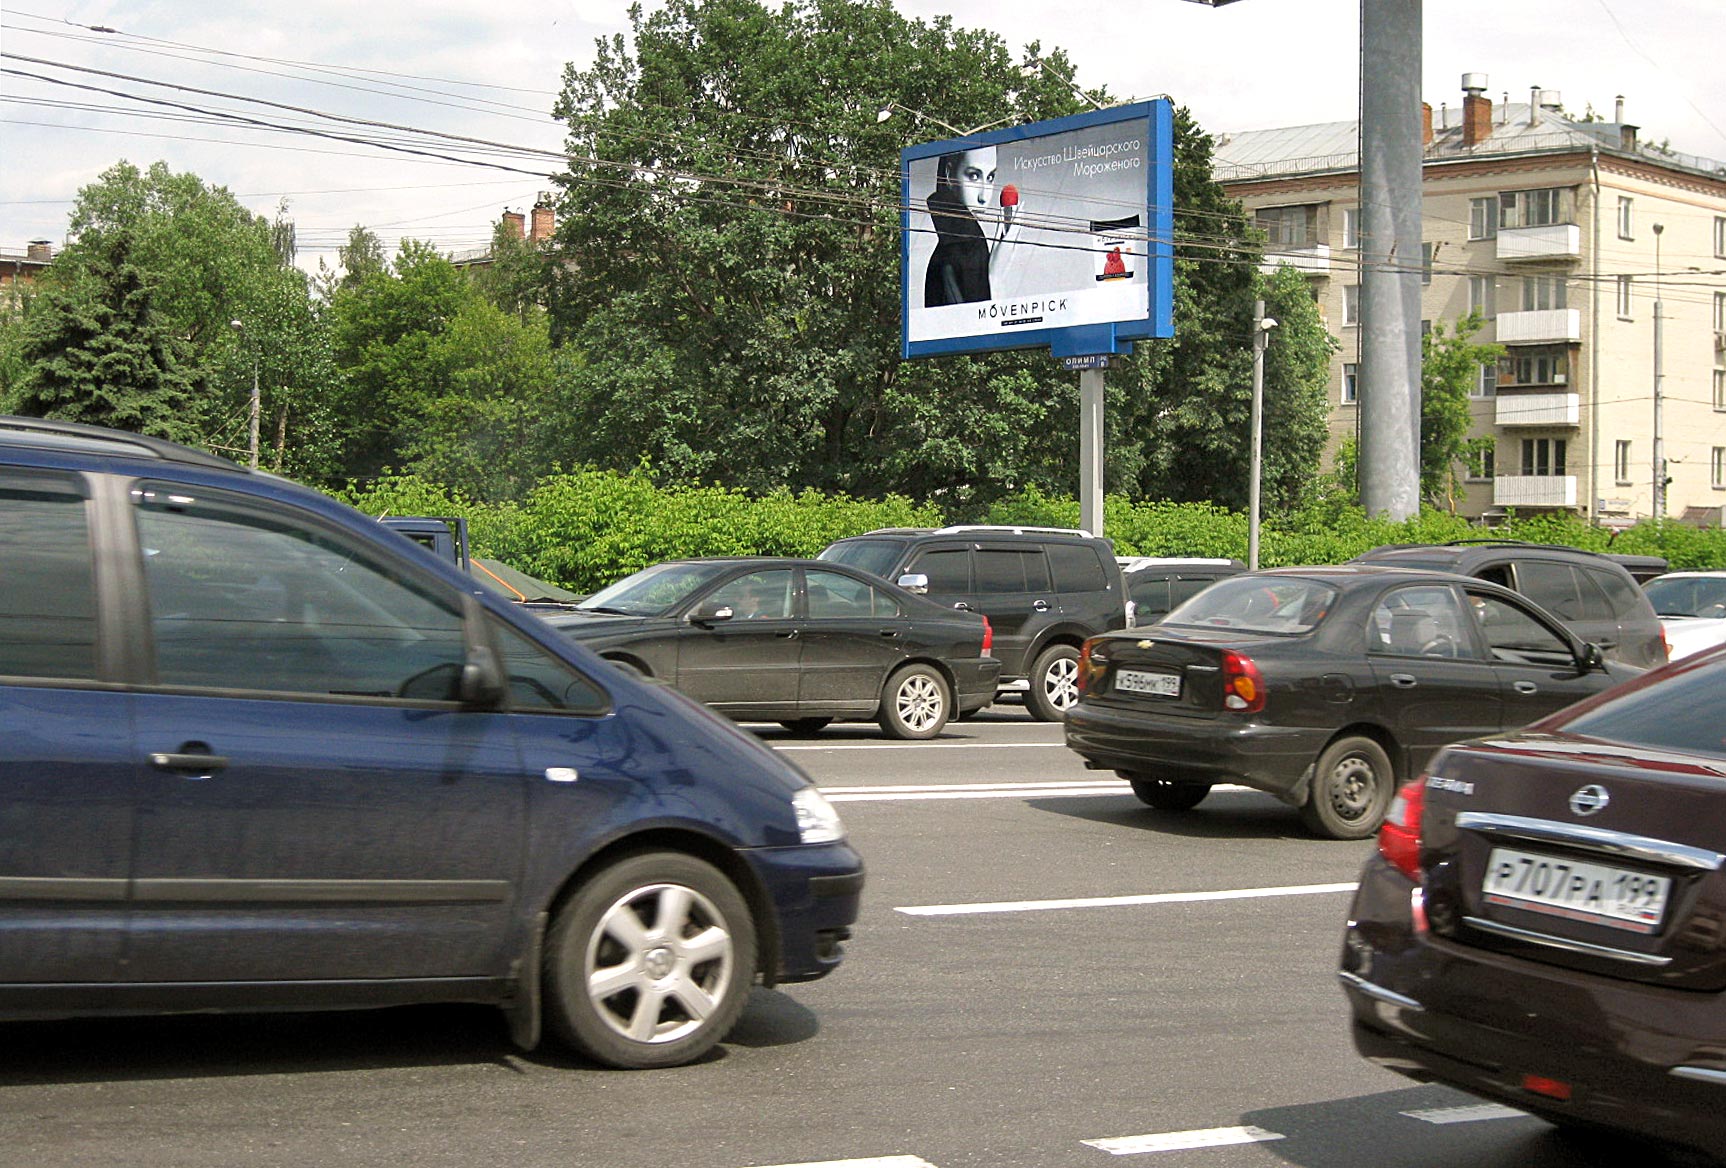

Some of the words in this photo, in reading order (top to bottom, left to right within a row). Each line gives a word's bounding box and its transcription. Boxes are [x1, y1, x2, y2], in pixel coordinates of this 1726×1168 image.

[1014, 153, 1062, 173] Искусство
[1063, 139, 1141, 162] Швейцарского
[1073, 157, 1141, 178] Мороженого
[1065, 356, 1095, 366] ОЛИМП
[1613, 874, 1659, 907] 199
